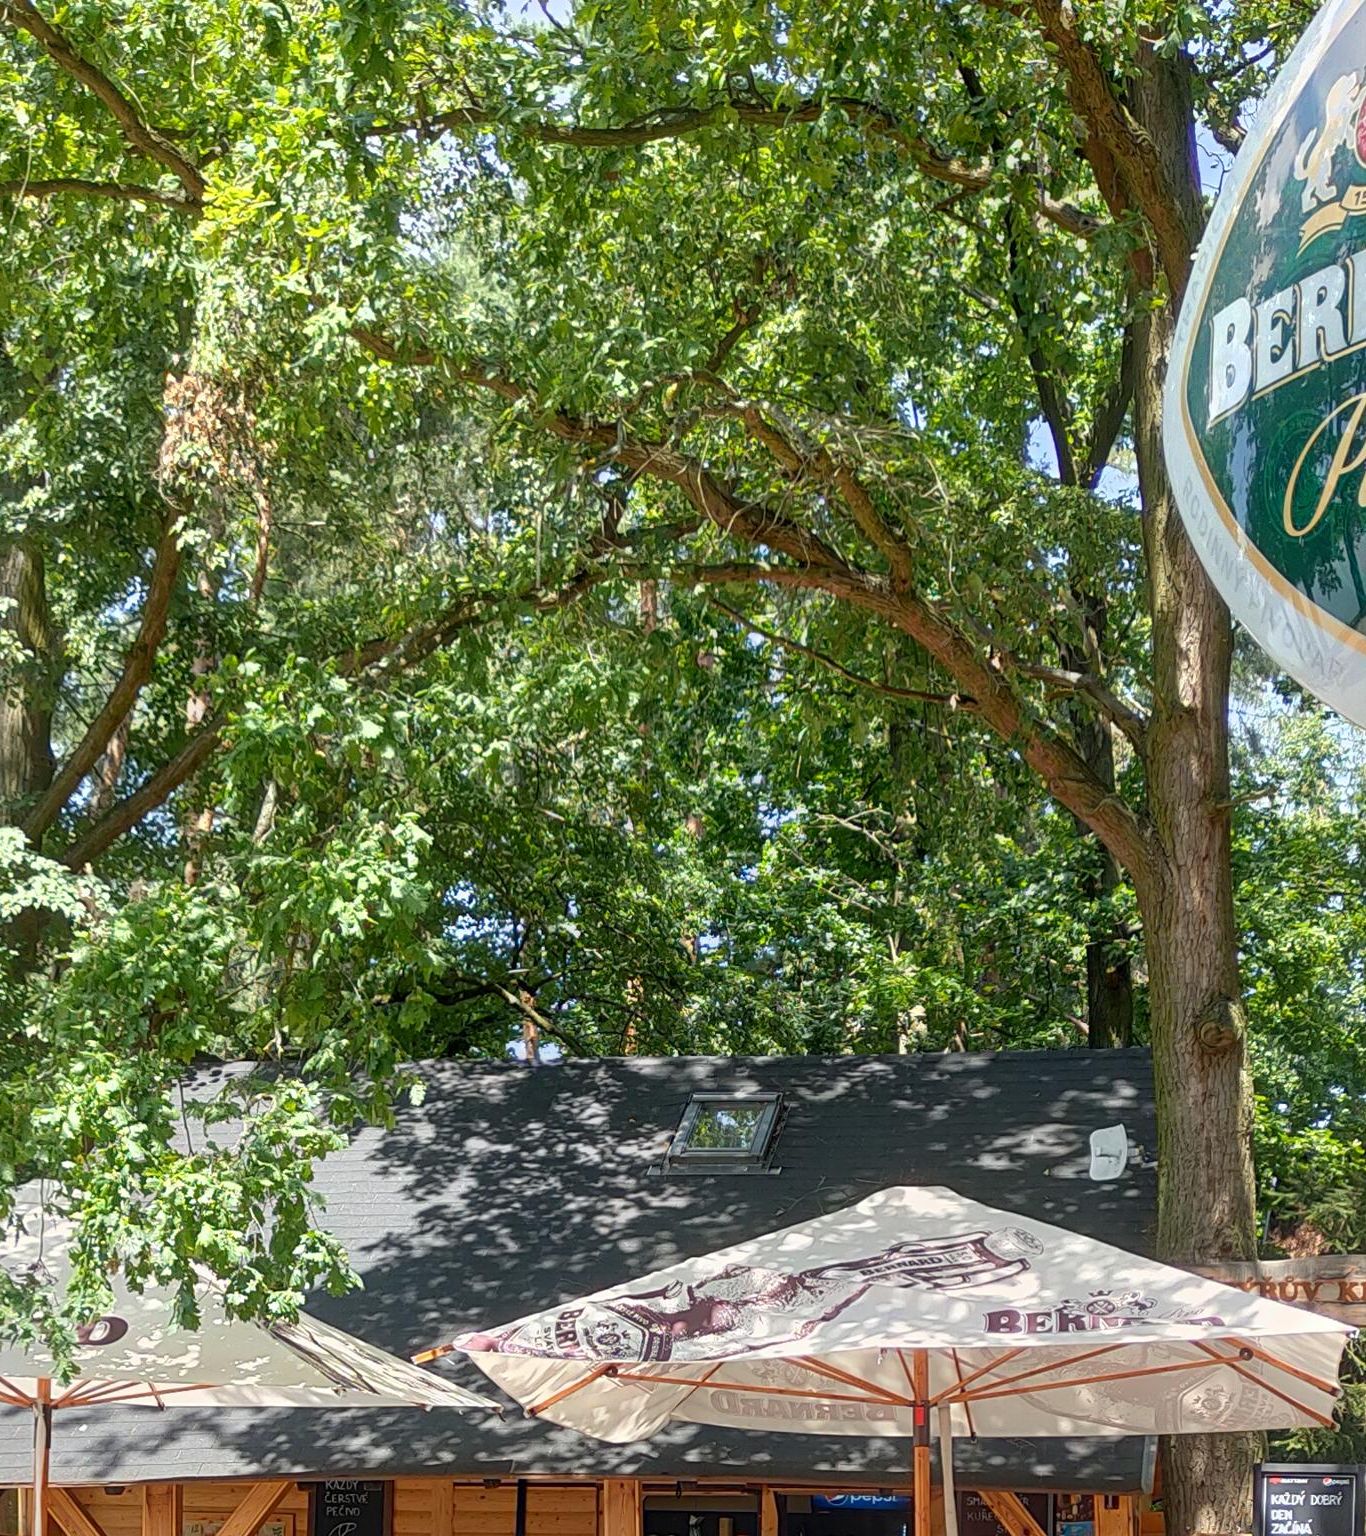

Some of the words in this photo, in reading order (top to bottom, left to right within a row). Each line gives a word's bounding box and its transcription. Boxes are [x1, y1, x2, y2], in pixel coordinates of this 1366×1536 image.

[860, 1256, 944, 1278] BERNARD
[324, 1491, 369, 1504] ČERSTVÉ
[1270, 1490, 1306, 1506] KAŽDÝ
[1310, 1491, 1343, 1506] DOBRÝ
[326, 1505, 361, 1516] PEČIVO
[966, 1508, 995, 1521] KUŘE
[1270, 1509, 1293, 1521] DEN
[1270, 1519, 1313, 1535] ZAČÍNÁ
